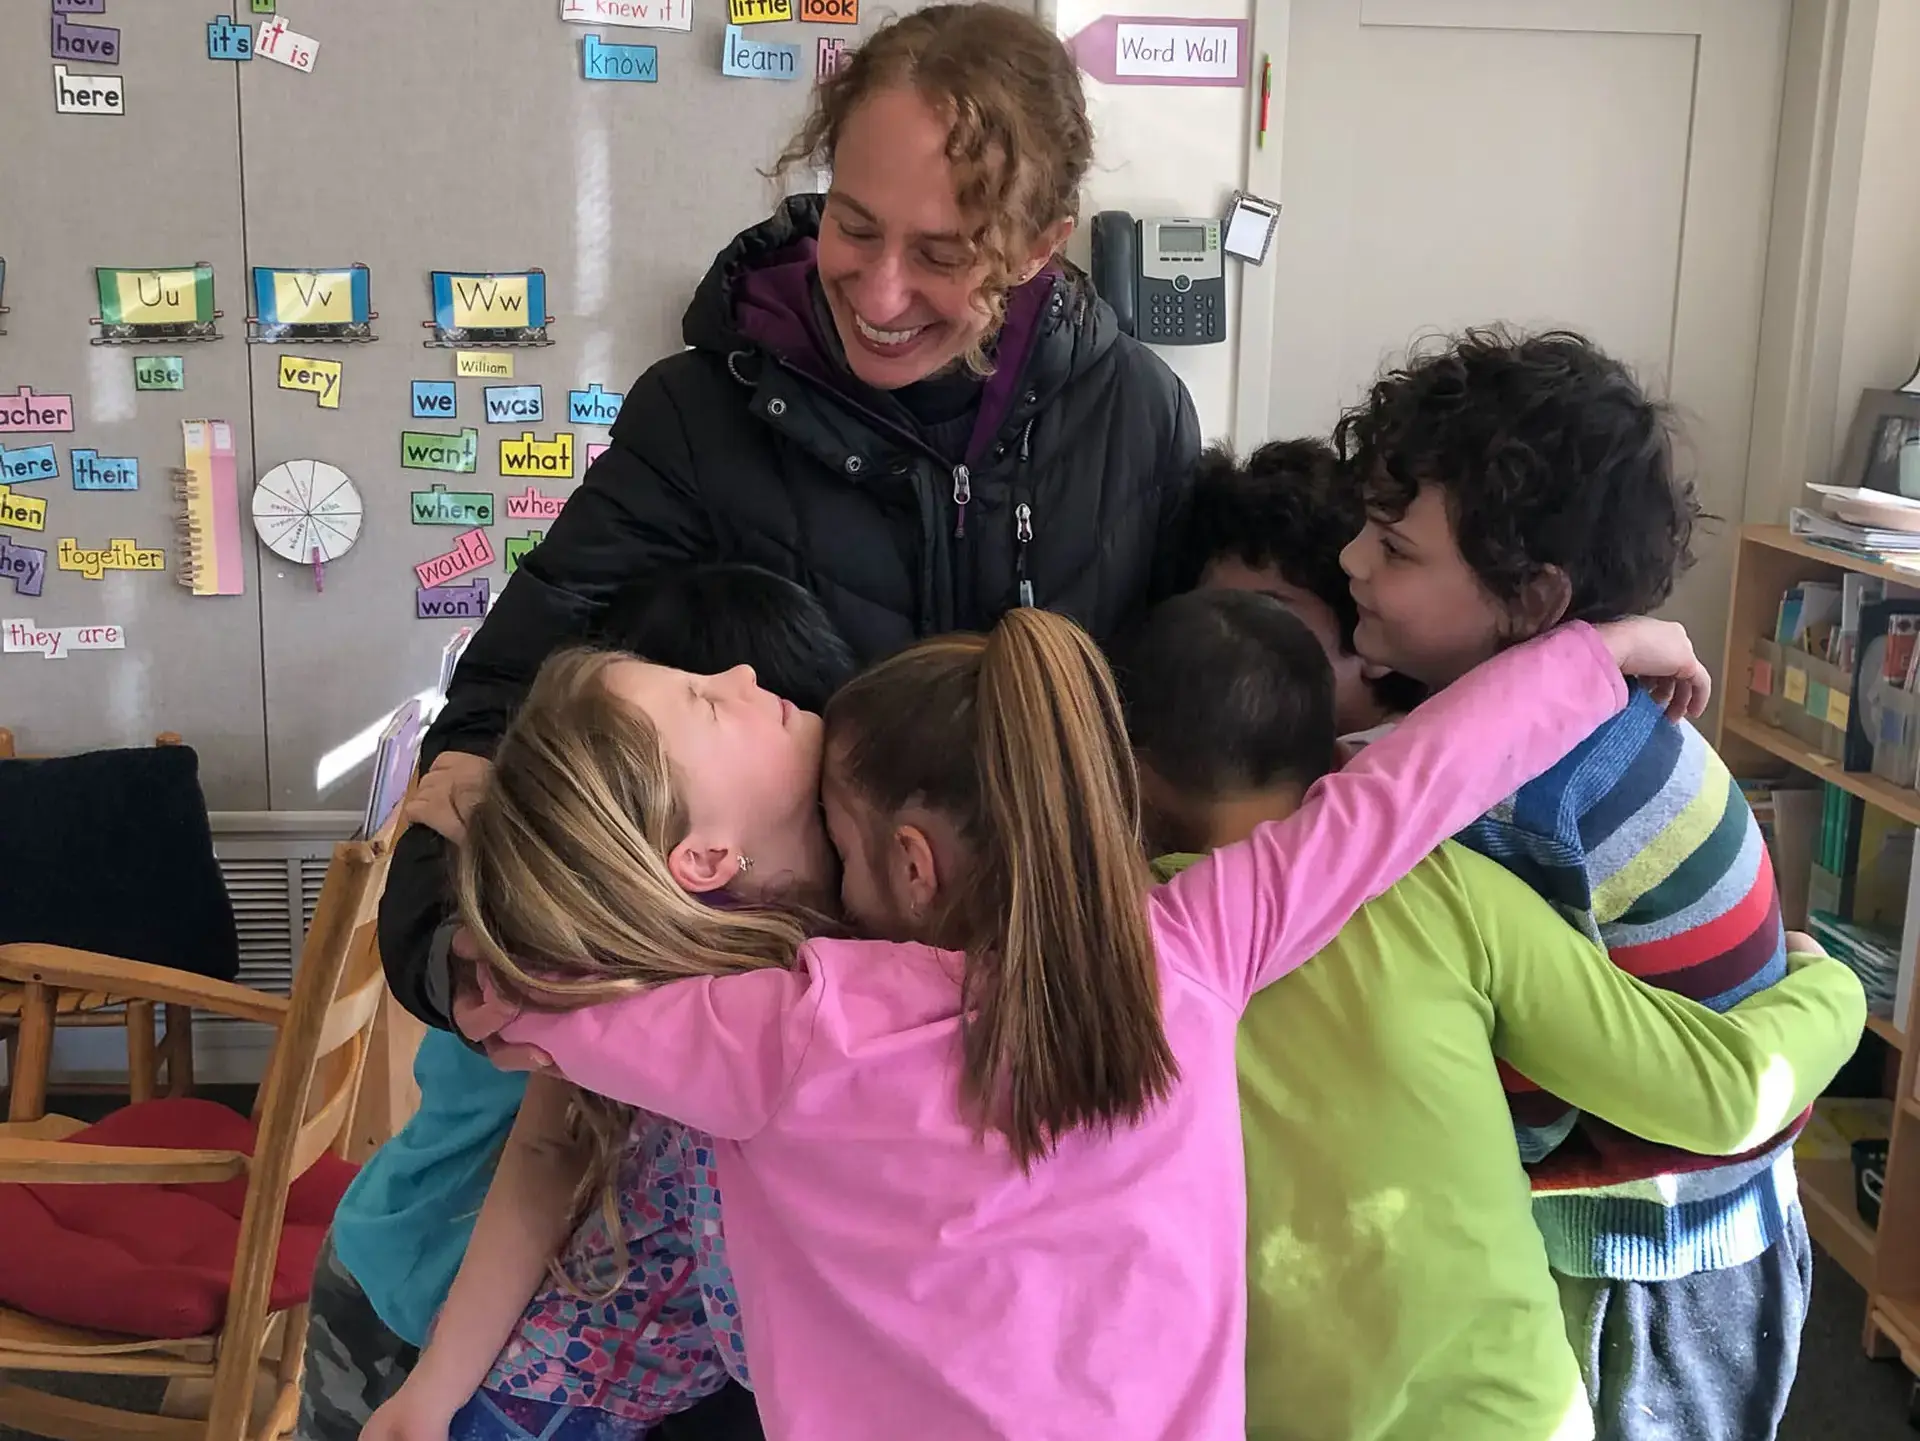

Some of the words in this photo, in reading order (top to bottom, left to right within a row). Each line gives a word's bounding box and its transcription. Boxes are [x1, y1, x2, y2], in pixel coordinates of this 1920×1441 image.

[733, 0, 787, 16] little
[804, 0, 853, 16] look
[57, 24, 114, 56] have
[213, 26, 249, 53] it's
[261, 23, 284, 54] it
[290, 44, 309, 67] is
[731, 33, 793, 72] learn
[1122, 37, 1174, 62] Word
[1186, 37, 1227, 63] Wall
[591, 43, 654, 75] know
[59, 75, 119, 107] here
[138, 277, 180, 307] Uu
[294, 277, 332, 307] Vv
[457, 282, 522, 311] Ww
[139, 368, 180, 384] use
[461, 361, 507, 374] William
[284, 367, 337, 398] very
[0, 398, 68, 425] acher
[417, 394, 453, 411] we
[490, 399, 540, 416] was
[574, 394, 619, 418] who
[408, 438, 473, 465] want
[506, 443, 569, 470] what
[0, 455, 53, 477] here
[77, 459, 133, 484] their
[0, 494, 42, 524] hen
[416, 493, 490, 519] where
[0, 546, 40, 585] hey
[60, 542, 160, 575] together
[419, 533, 489, 583] would
[422, 590, 487, 614] won't
[11, 624, 61, 655] they
[78, 627, 117, 644] are
